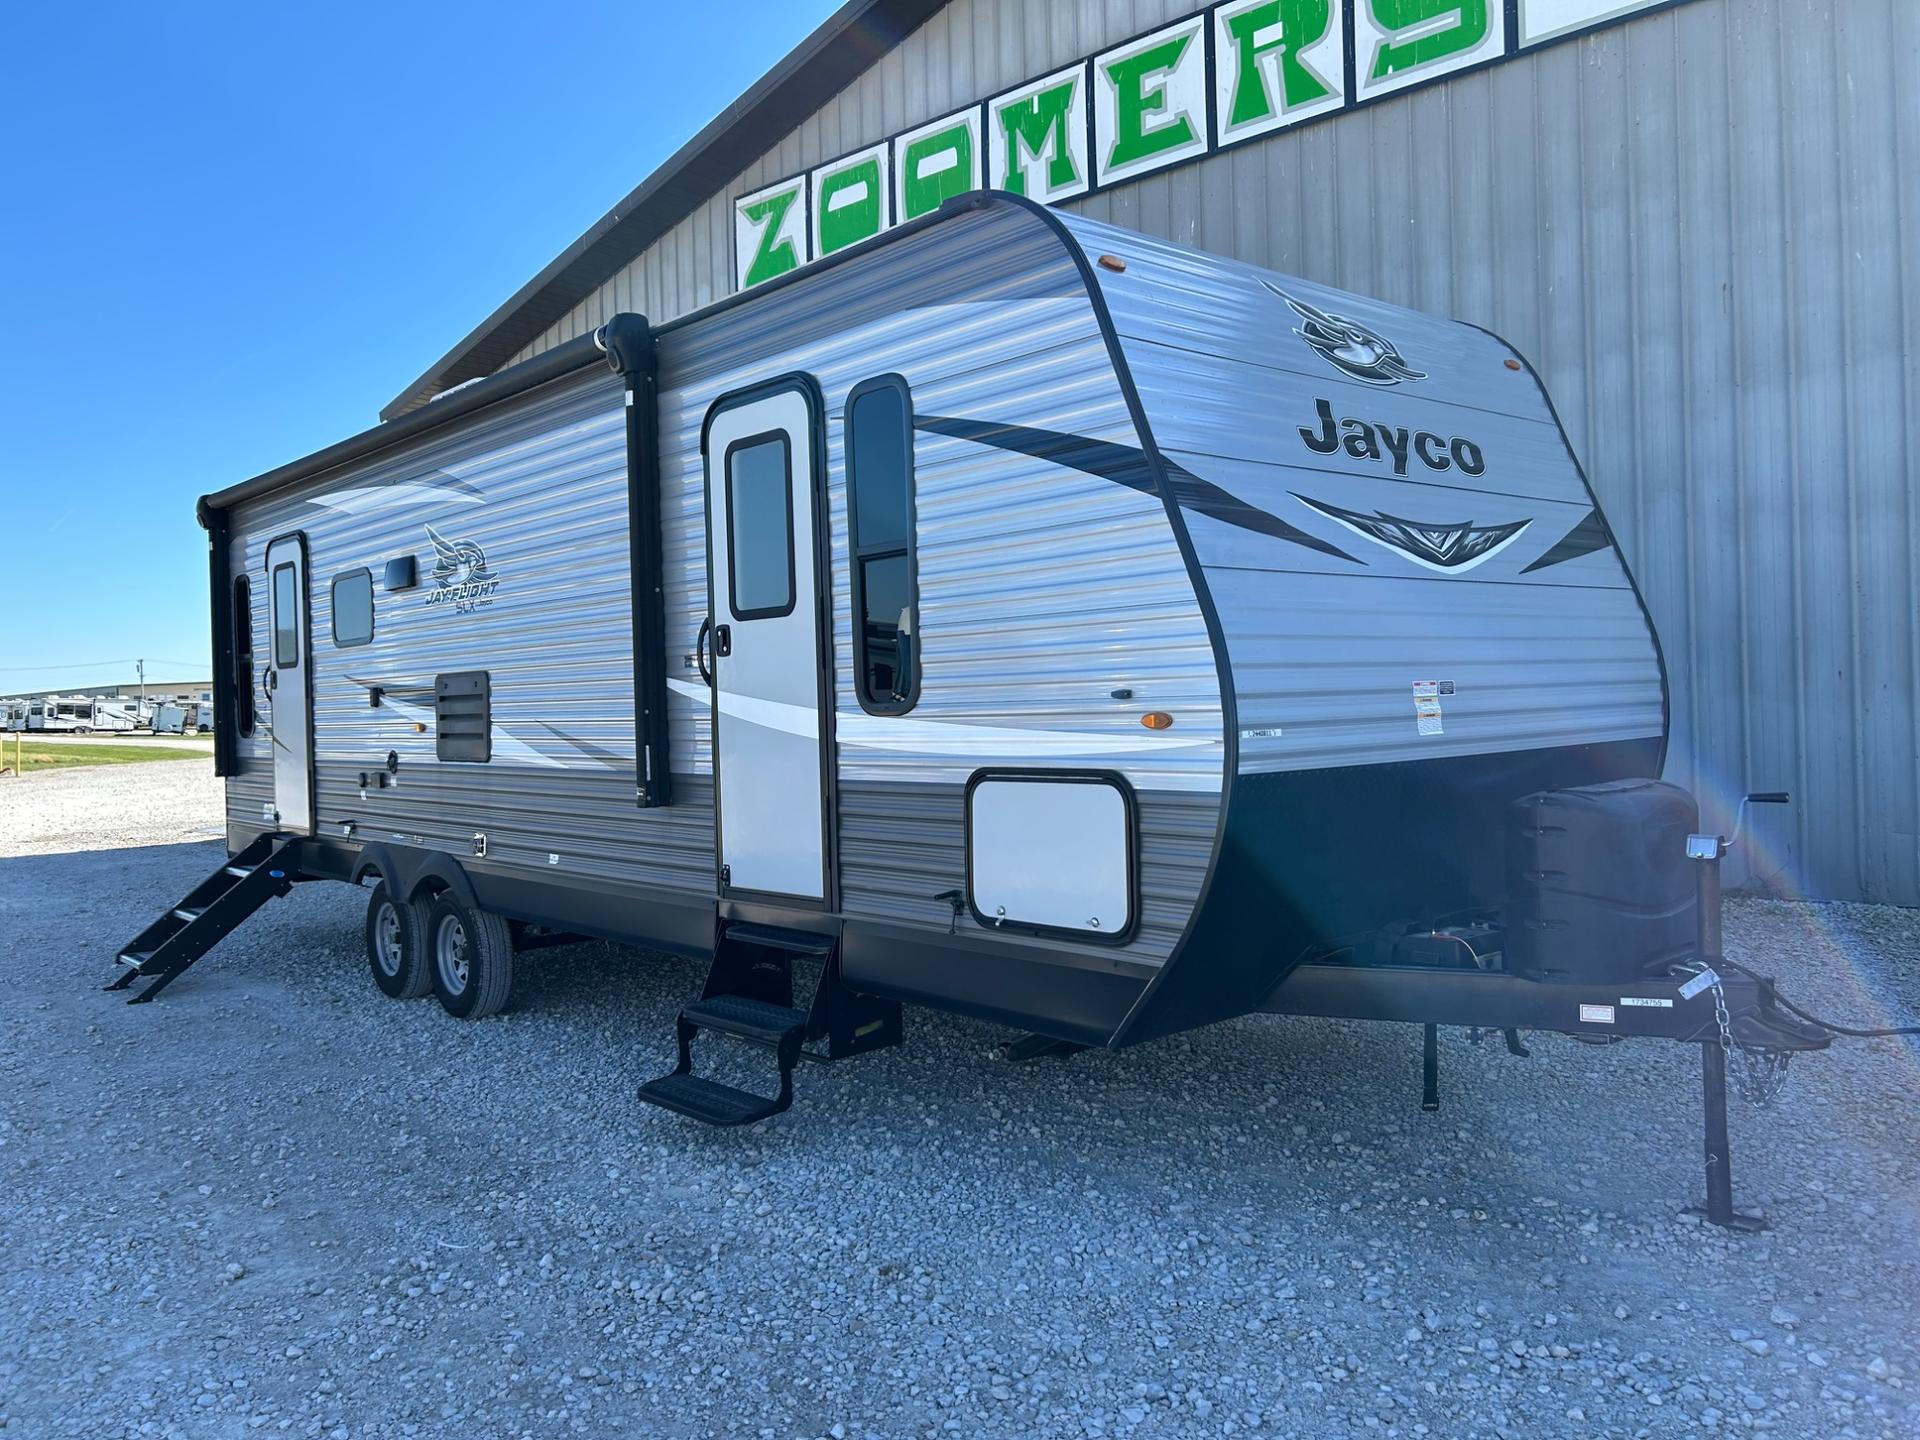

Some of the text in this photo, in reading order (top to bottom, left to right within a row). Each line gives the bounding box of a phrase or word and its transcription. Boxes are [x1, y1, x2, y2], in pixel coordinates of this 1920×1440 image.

[738, 0, 1493, 288] ZOOMERS
[1296, 397, 1486, 477] Jayco
[455, 600, 475, 614] SLX
